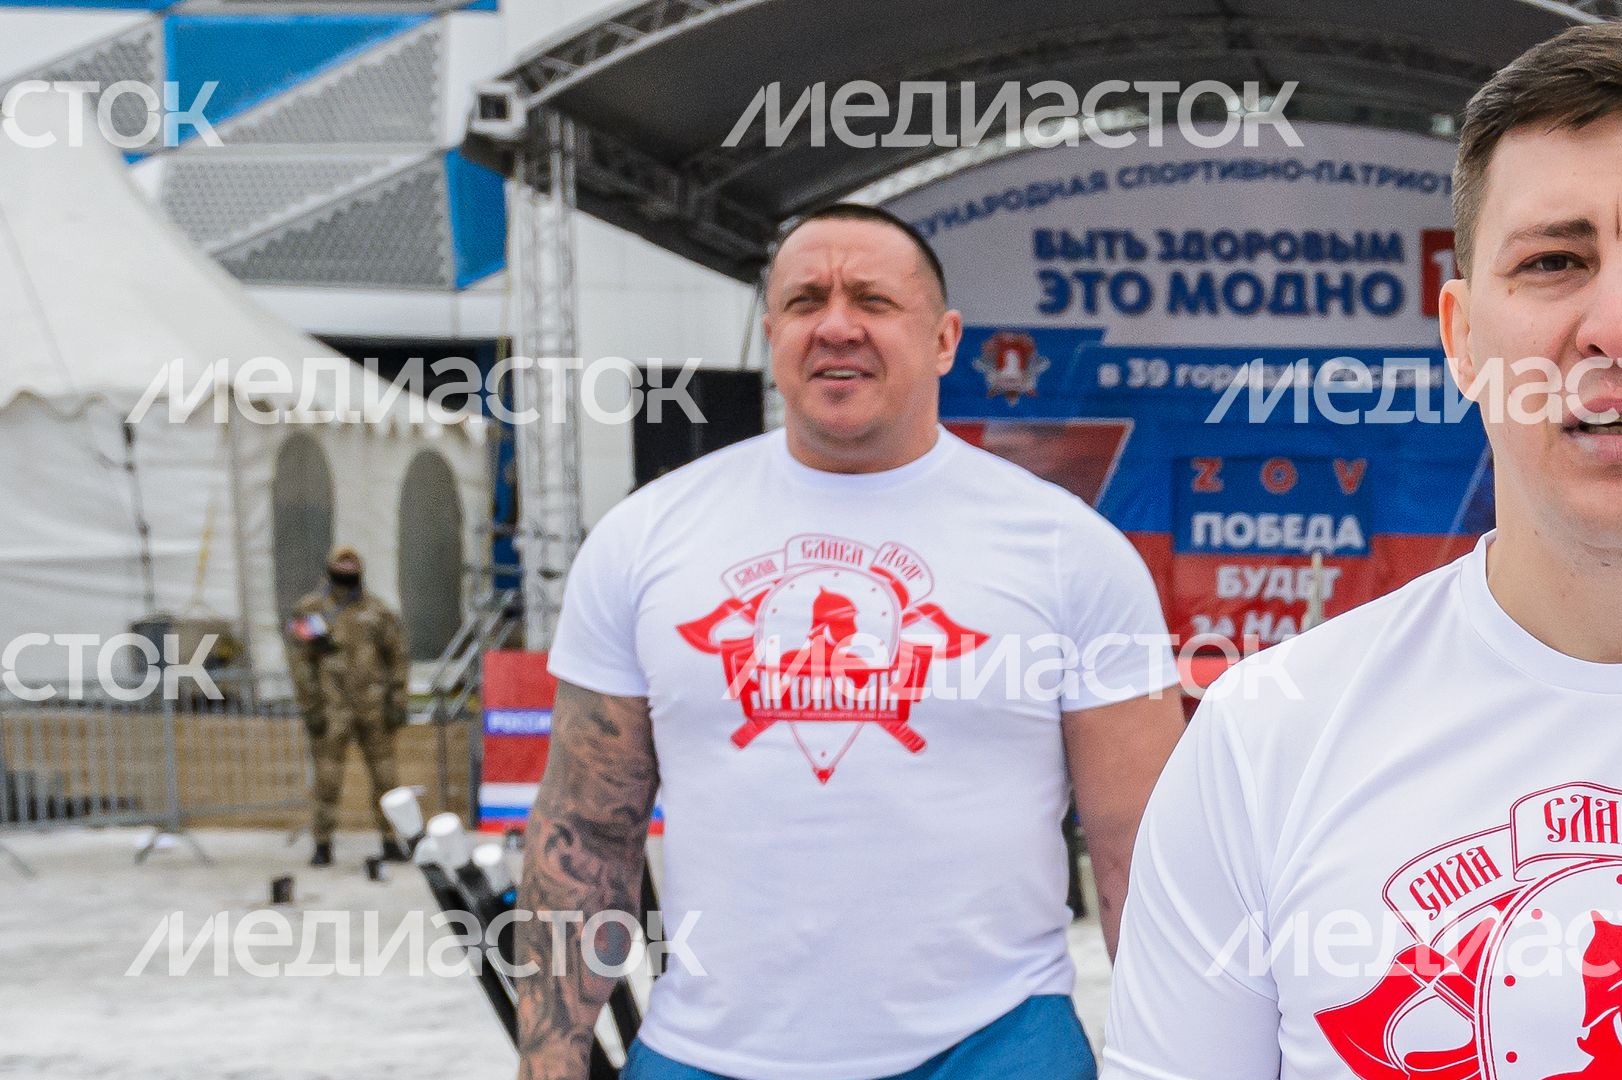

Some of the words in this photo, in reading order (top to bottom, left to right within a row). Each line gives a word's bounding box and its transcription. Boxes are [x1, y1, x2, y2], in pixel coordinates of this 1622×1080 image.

[1033, 228, 1147, 261] БЫТЬ
[1155, 228, 1404, 262] ЗДОРОВЫМ
[1037, 268, 1153, 317] ЭТО
[1167, 269, 1404, 317] МОДНО
[1191, 511, 1367, 553] ПОБЕДА
[1216, 565, 1343, 604] БУДЕТ
[1244, 609, 1301, 641] НА
[1409, 845, 1504, 922] СИЛА
